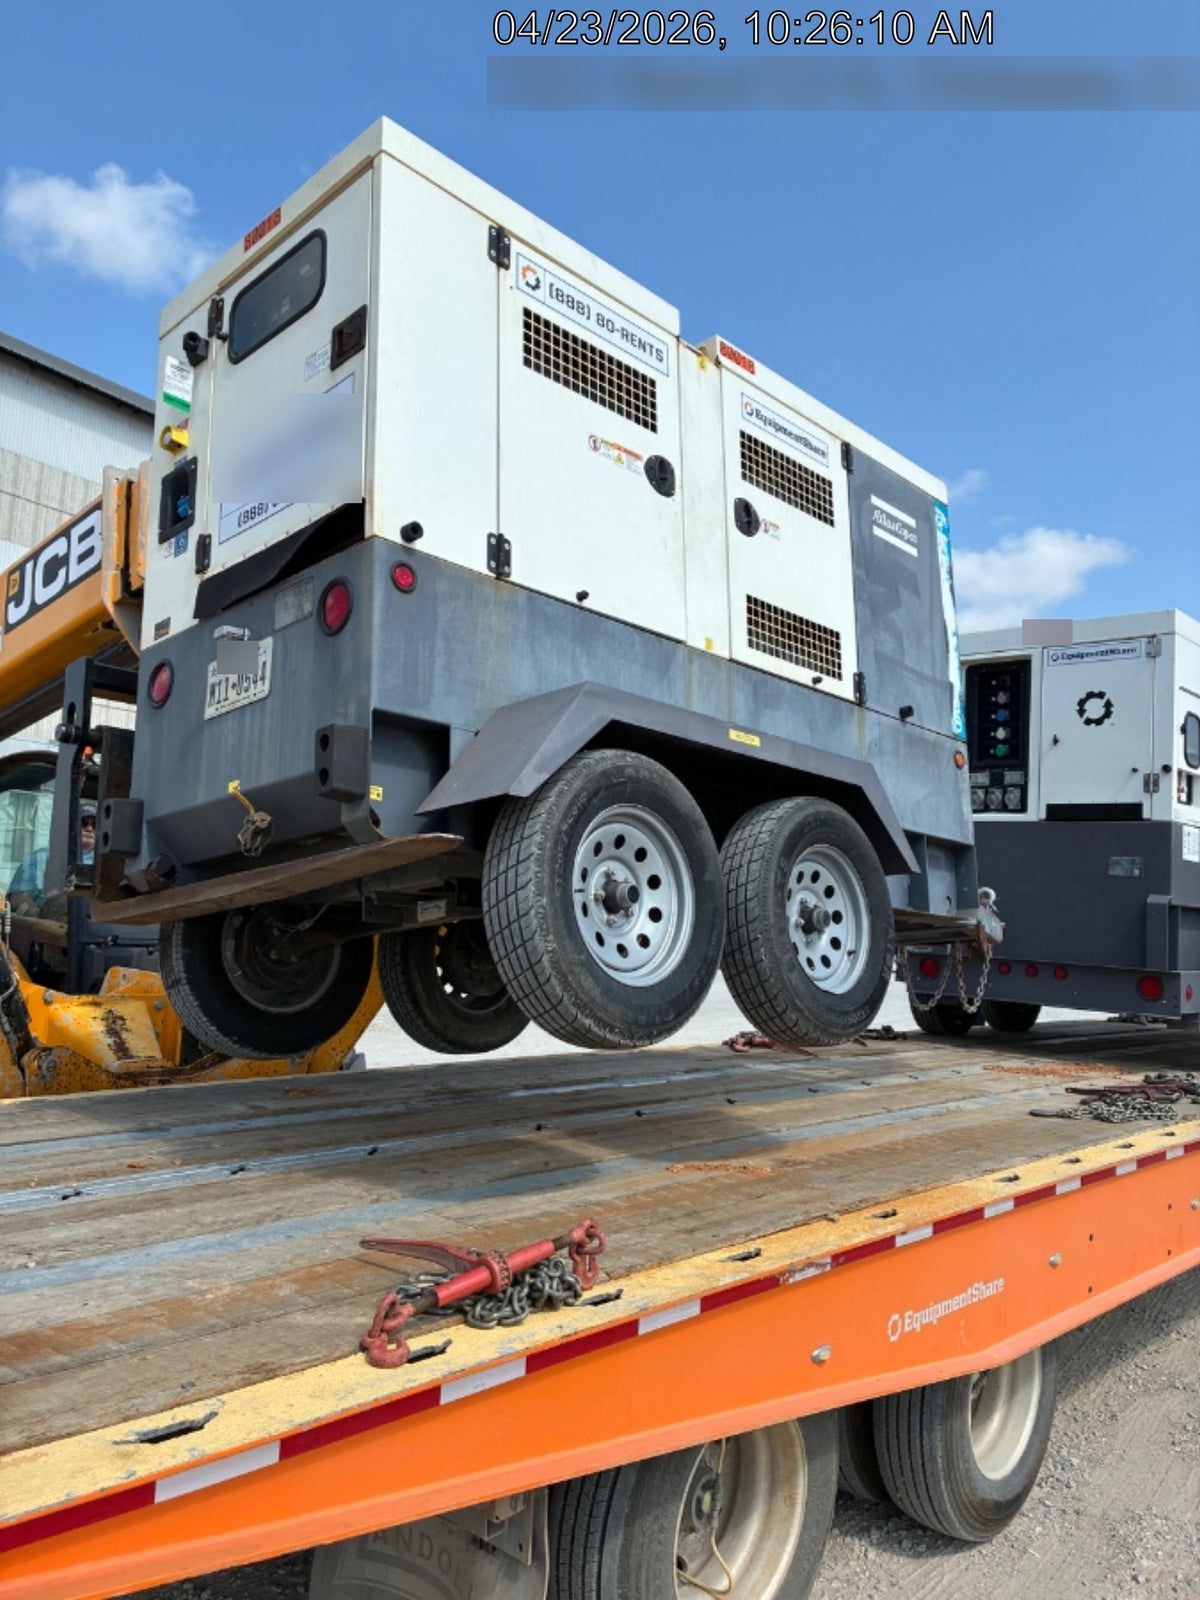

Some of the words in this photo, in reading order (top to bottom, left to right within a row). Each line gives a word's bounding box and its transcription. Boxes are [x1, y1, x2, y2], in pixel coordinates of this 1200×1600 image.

[549, 283, 591, 321] (888)
[596, 312, 664, 363] 80-RENTS
[7, 509, 102, 625] JCB
[903, 1278, 1005, 1332] EquipmentShare
